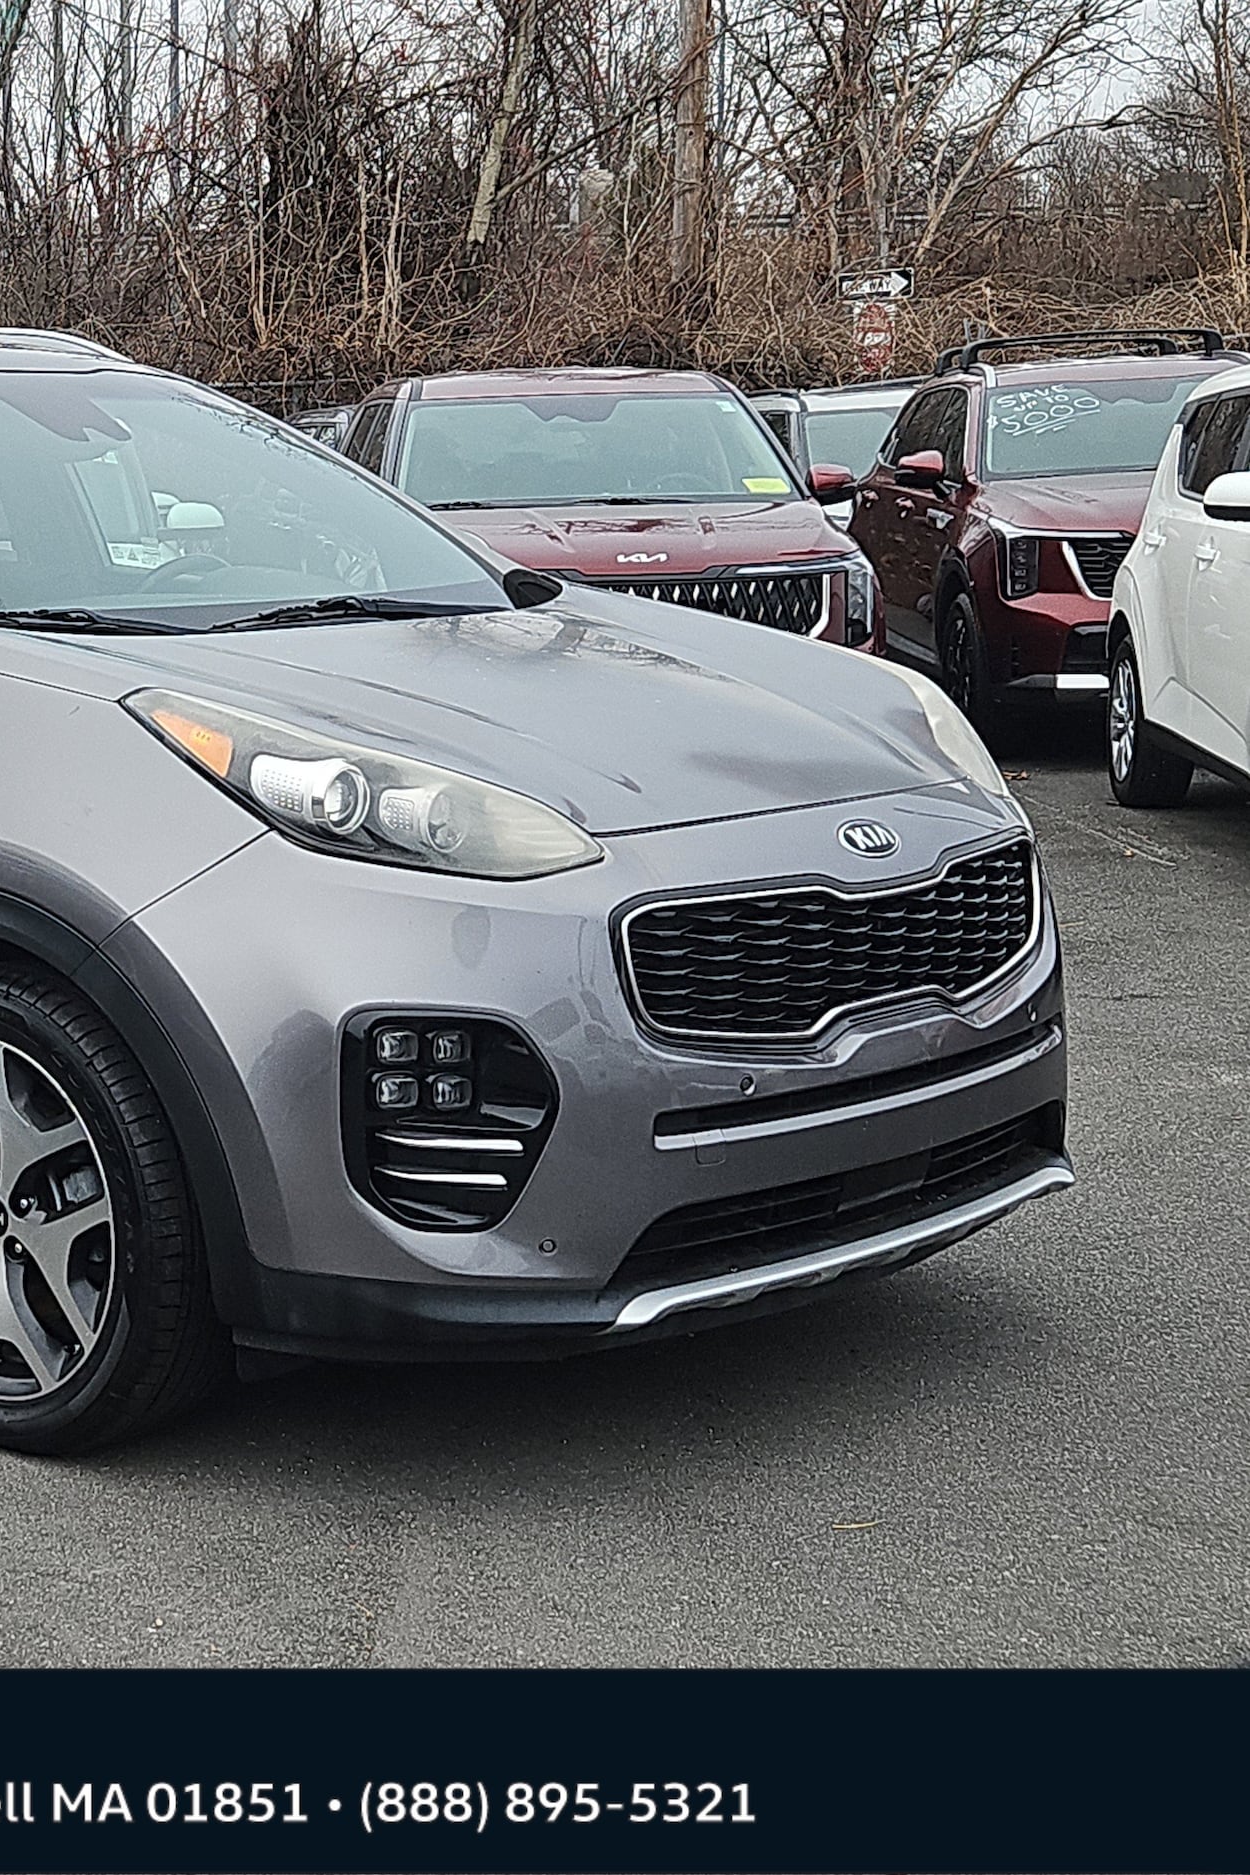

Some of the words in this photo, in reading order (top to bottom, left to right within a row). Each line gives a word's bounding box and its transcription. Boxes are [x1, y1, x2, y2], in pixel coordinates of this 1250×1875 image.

[869, 278, 891, 291] WAY
[996, 384, 1070, 409] SAVE
[987, 397, 1100, 433] $5000
[846, 824, 895, 850] KIA
